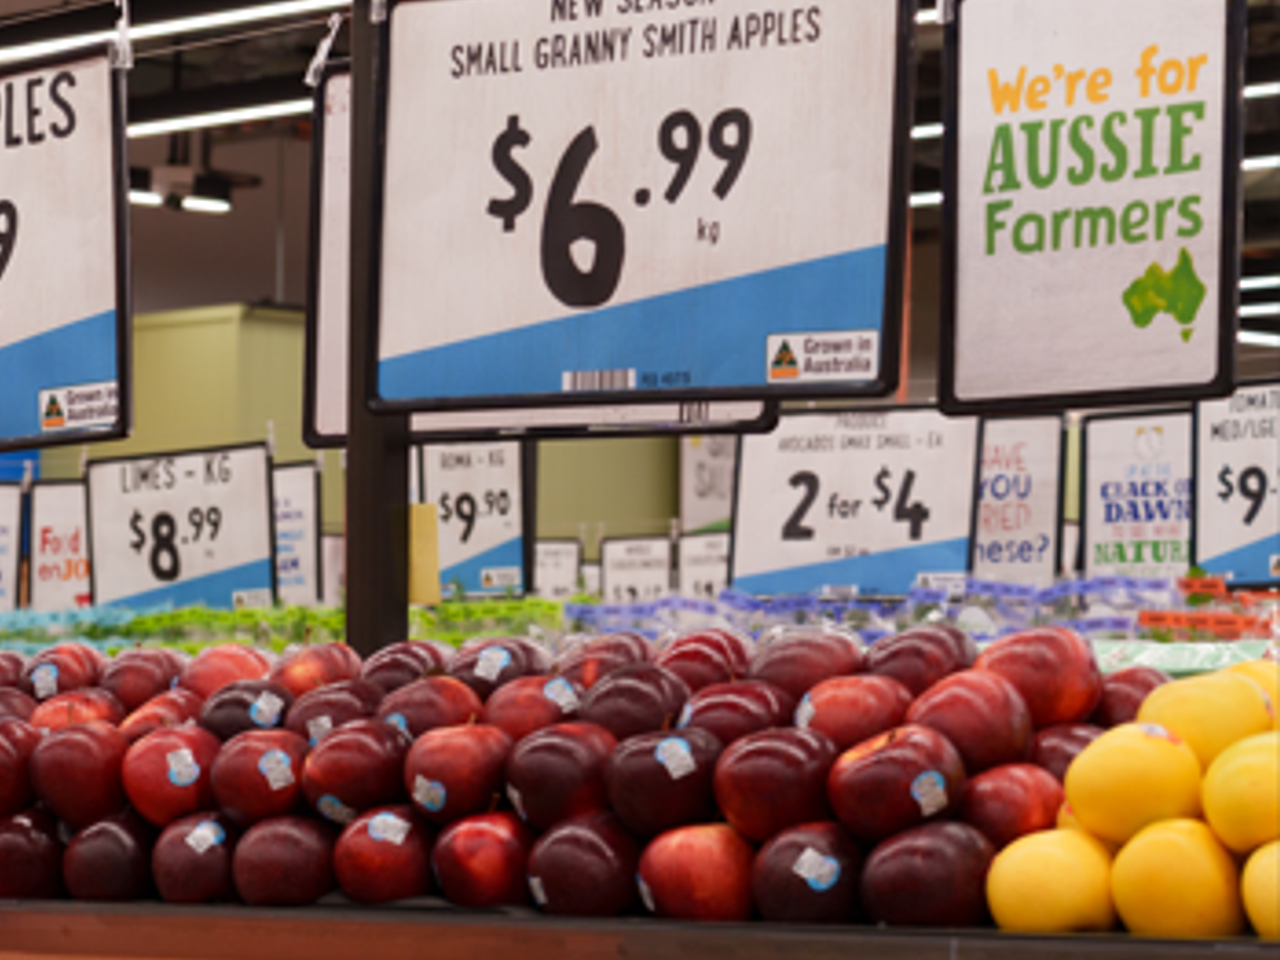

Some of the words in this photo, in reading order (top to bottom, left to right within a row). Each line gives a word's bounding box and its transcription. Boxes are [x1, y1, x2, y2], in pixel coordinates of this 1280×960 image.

[450, 44, 524, 79] SMALL
[535, 27, 633, 70] GRANNY
[642, 17, 717, 58] SMITH
[726, 7, 822, 52] APPLES
[986, 63, 1113, 116] We're
[1135, 44, 1209, 99] for
[983, 101, 1207, 195] AUSSIE
[487, 107, 754, 309] $6.99
[696, 217, 721, 244] kg
[986, 195, 1204, 256] Farmers
[803, 336, 853, 354] Grown
[858, 335, 873, 352] in
[804, 354, 872, 374] Australia
[1229, 390, 1280, 413] TOMAT
[121, 458, 176, 494] LIMES
[981, 442, 1029, 472] AVE
[438, 488, 513, 544] $9.90
[781, 470, 820, 541] 2
[871, 464, 930, 541] $4
[981, 502, 1032, 532] RIED
[1217, 463, 1280, 526] $9.
[129, 506, 222, 582] $8.99
[977, 533, 1050, 563] ese?
